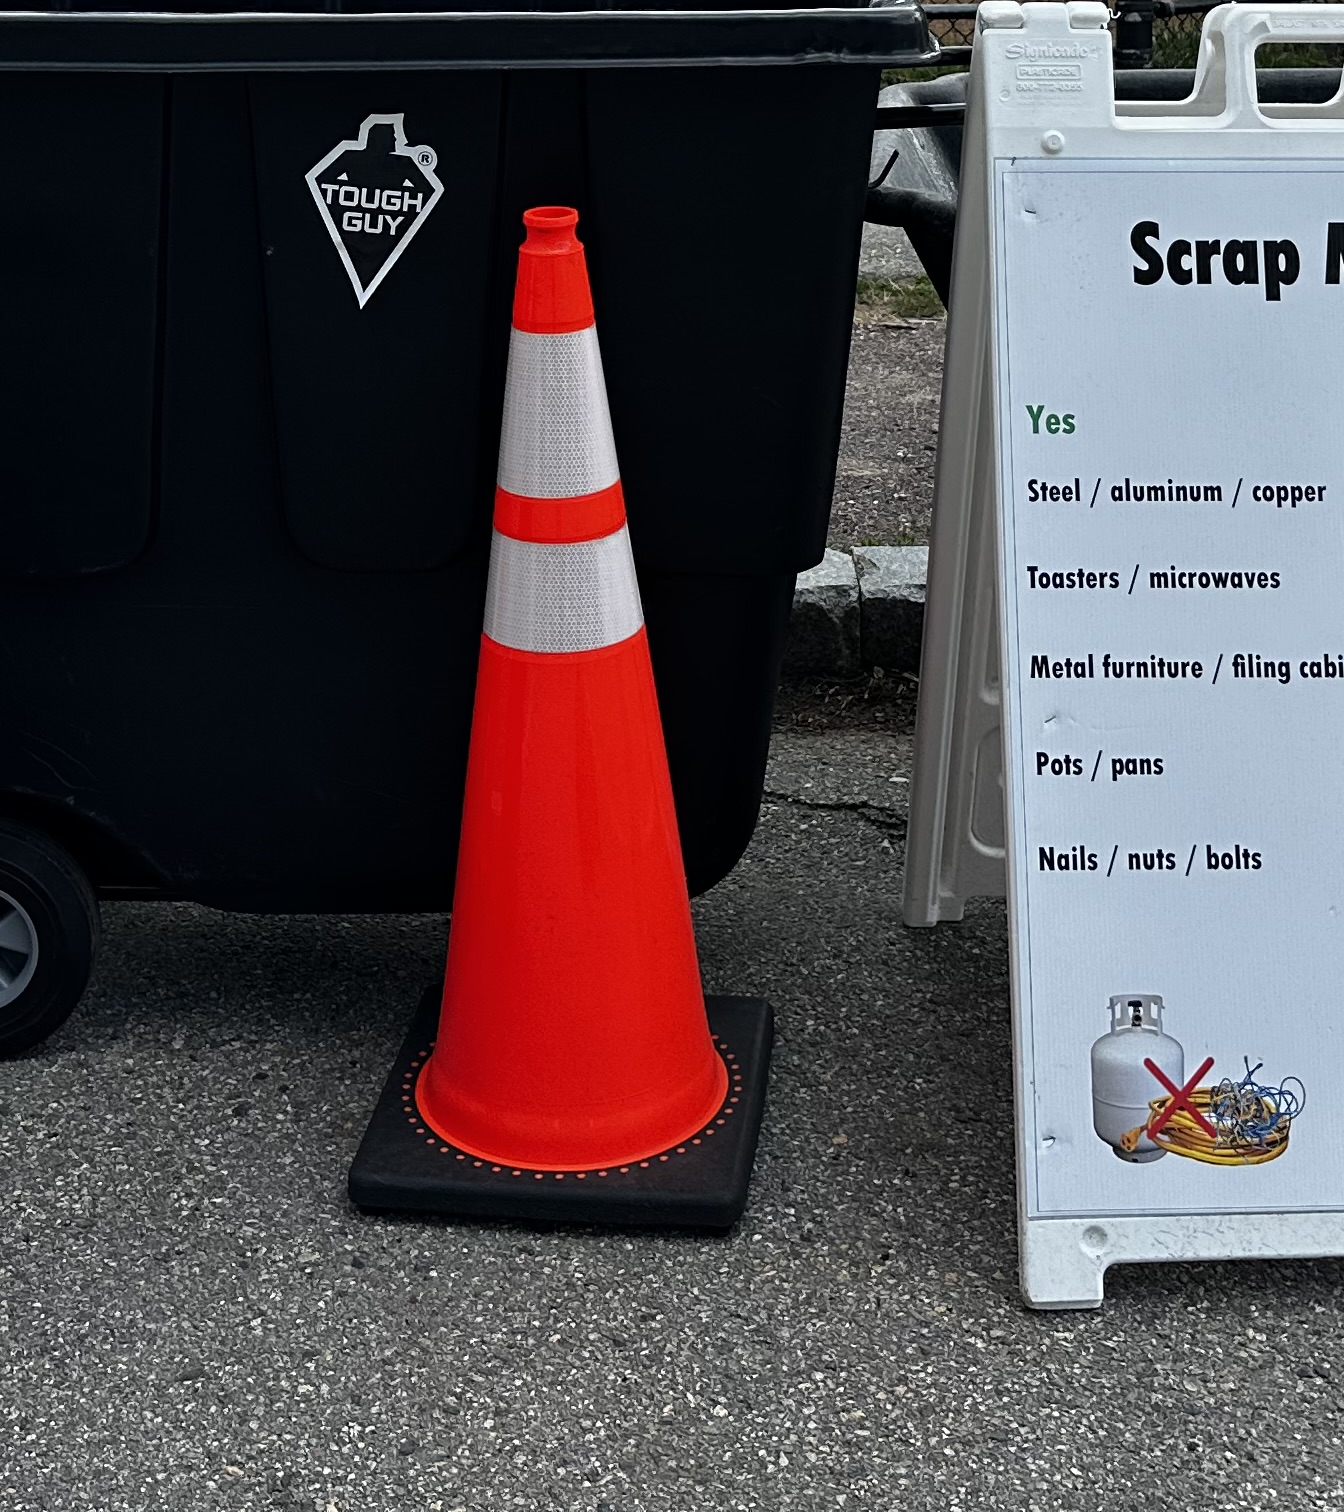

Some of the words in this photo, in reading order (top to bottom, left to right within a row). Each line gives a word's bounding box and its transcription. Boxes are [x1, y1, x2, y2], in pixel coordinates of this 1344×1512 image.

[321, 183, 423, 212] TOUGH
[342, 211, 405, 236] GUY
[1130, 221, 1301, 301] Scrap
[1025, 405, 1076, 435] Yes
[1027, 478, 1081, 503] Steel
[1089, 478, 1102, 508] /
[1110, 479, 1223, 502] aluminum
[1232, 478, 1243, 508] /
[1252, 484, 1327, 508] copper
[1027, 566, 1119, 589] Toasters
[1128, 564, 1139, 594] /
[1149, 565, 1281, 588] microwaves
[1030, 654, 1094, 679] Metal
[1102, 654, 1204, 678] furniture
[1212, 654, 1224, 684] /
[1232, 654, 1291, 684] filing
[1036, 752, 1083, 775] Pots
[1090, 750, 1103, 781] /
[1111, 758, 1164, 781] pans
[1038, 845, 1098, 870] Nails
[1106, 845, 1119, 877] /
[1128, 849, 1176, 870] nuts
[1185, 845, 1197, 876] /
[1206, 845, 1262, 870] bolts
